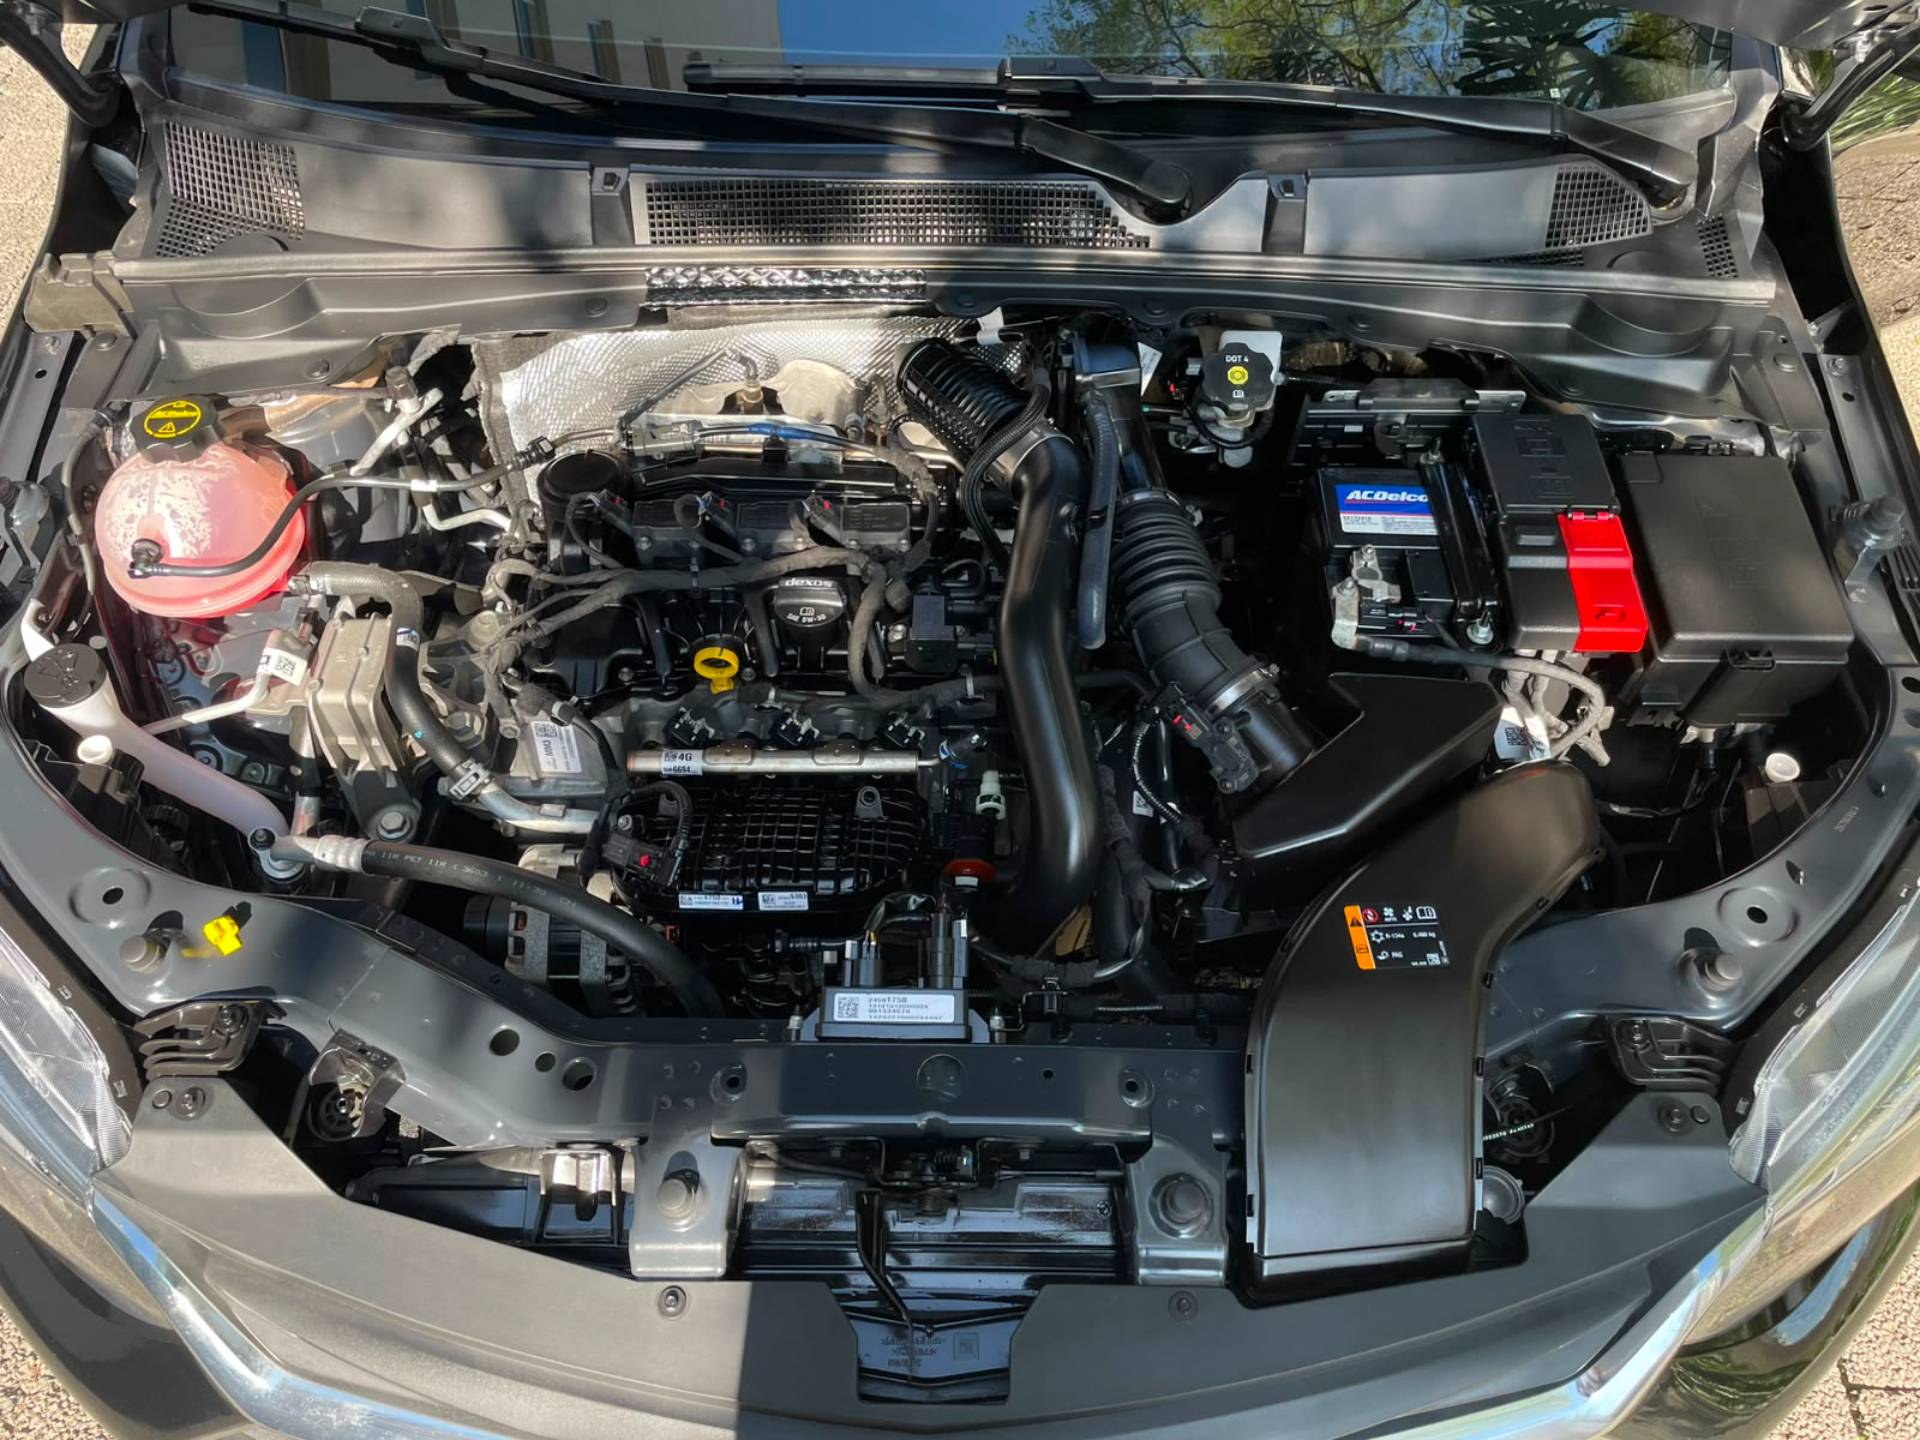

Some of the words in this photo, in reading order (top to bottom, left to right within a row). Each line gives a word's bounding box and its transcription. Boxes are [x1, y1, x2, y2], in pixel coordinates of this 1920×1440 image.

[1225, 354, 1242, 362] DOT
[1243, 354, 1249, 363] 4
[1346, 489, 1429, 503] ACDelco
[784, 577, 834, 588] dexos
